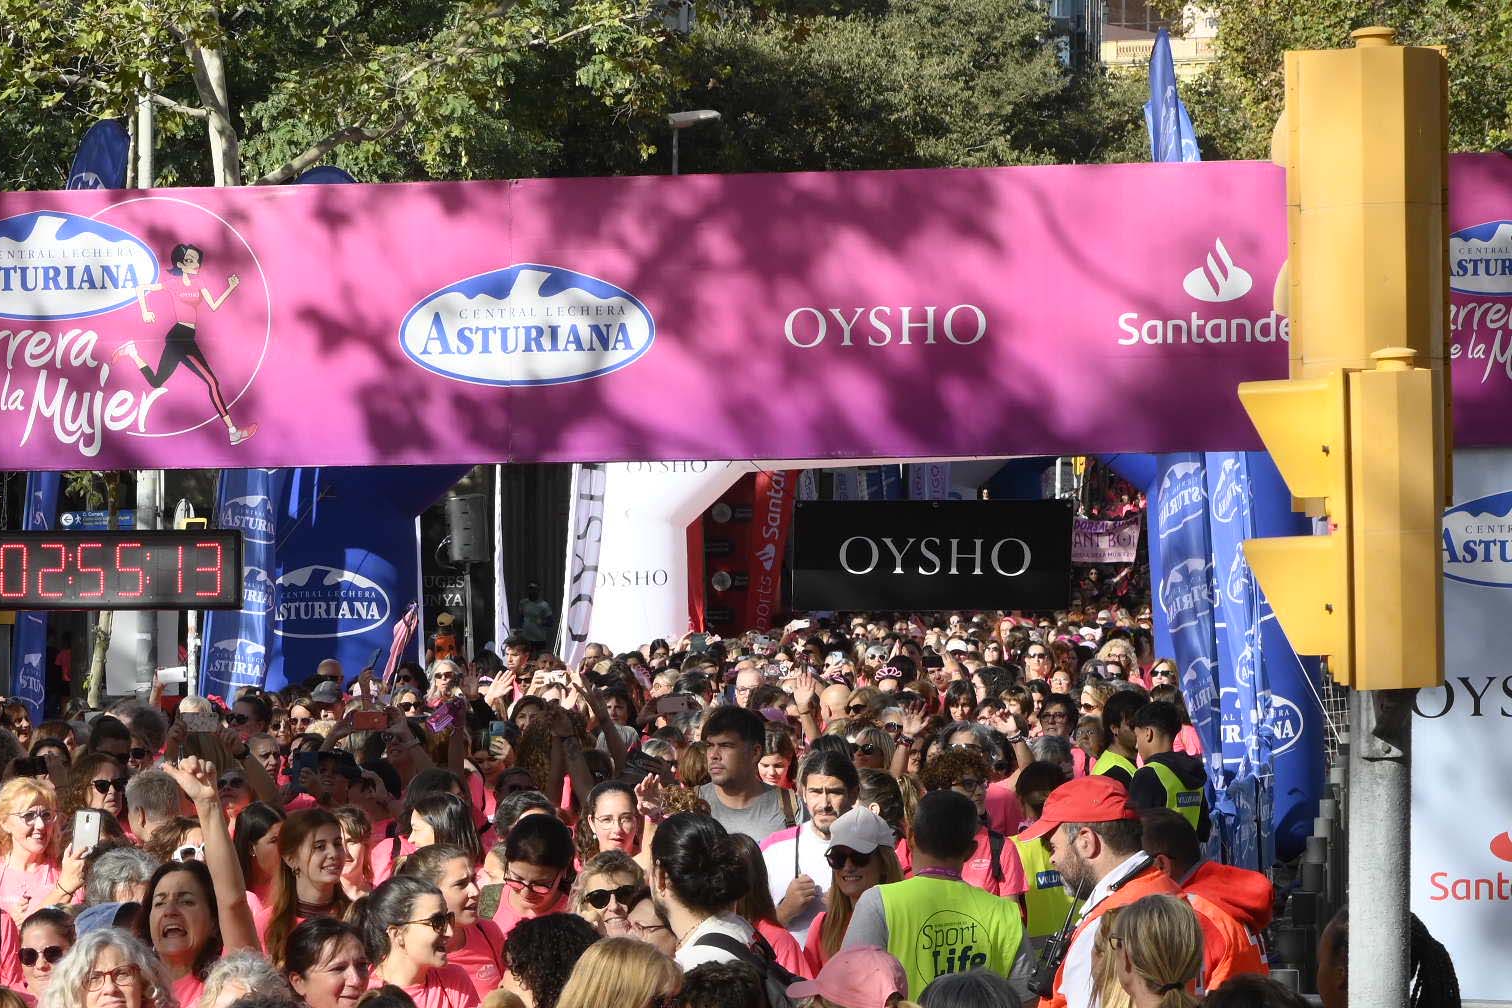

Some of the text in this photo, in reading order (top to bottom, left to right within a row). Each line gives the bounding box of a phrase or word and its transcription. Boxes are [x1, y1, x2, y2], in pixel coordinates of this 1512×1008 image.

[61, 247, 135, 259] LECHERA
[458, 303, 627, 320] CENTRAL LECHERA
[784, 303, 988, 349] OYSHO
[419, 310, 635, 356] ASTURIANA
[1117, 310, 1289, 345] Santande
[1468, 331, 1485, 359] la
[0, 371, 25, 412] la
[19, 363, 168, 457] Mujer
[1072, 531, 1100, 548] ANT
[0, 542, 221, 597] 02:55:13
[838, 535, 1032, 578] OYSHO
[280, 591, 321, 599] CENTRAL
[1430, 872, 1512, 901] Sant
[922, 922, 978, 951] Sport
